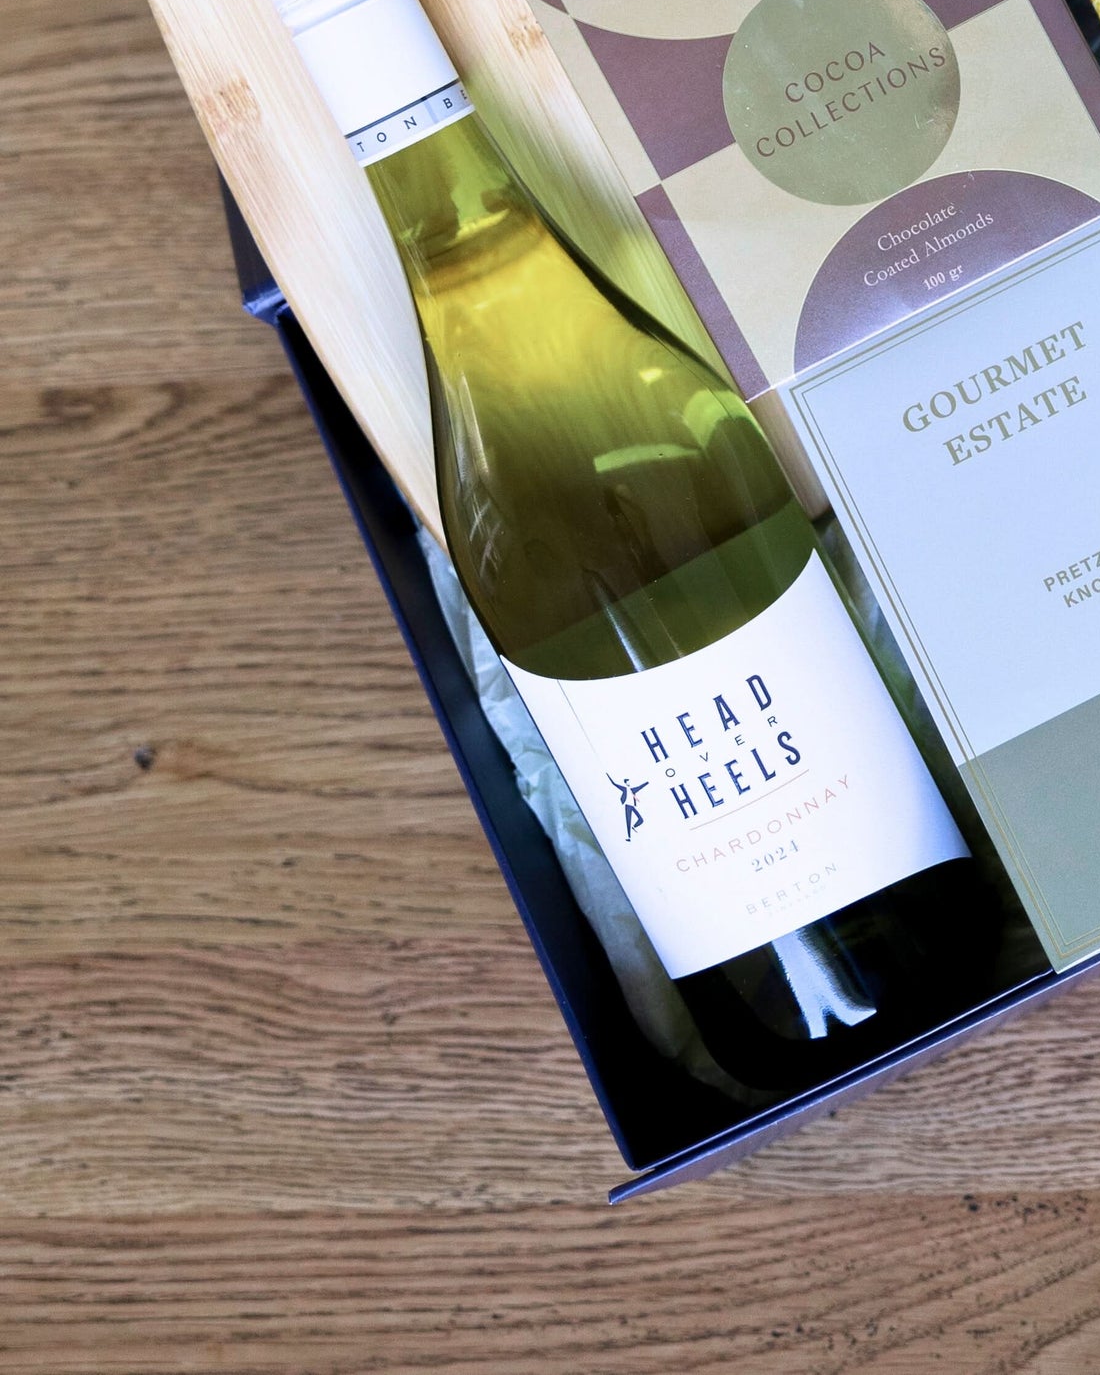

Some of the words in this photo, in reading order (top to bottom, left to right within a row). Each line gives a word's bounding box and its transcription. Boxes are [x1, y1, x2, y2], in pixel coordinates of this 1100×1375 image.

[755, 46, 946, 158] COLLECTIONS
[784, 41, 886, 105] COCOA
[862, 241, 921, 288] Coated
[924, 210, 994, 261] Almonds
[876, 203, 957, 254] Chocolate
[922, 270, 946, 292] 100
[949, 262, 965, 281] gr
[901, 321, 1088, 435] GOURMET
[941, 375, 1088, 466] ESTATE
[640, 674, 772, 763] HEAD
[665, 715, 778, 778] OVER
[669, 730, 802, 819] HEELS
[676, 774, 849, 872] CHARDONNAY
[751, 839, 799, 872] 2024
[745, 863, 837, 915] BERTON
